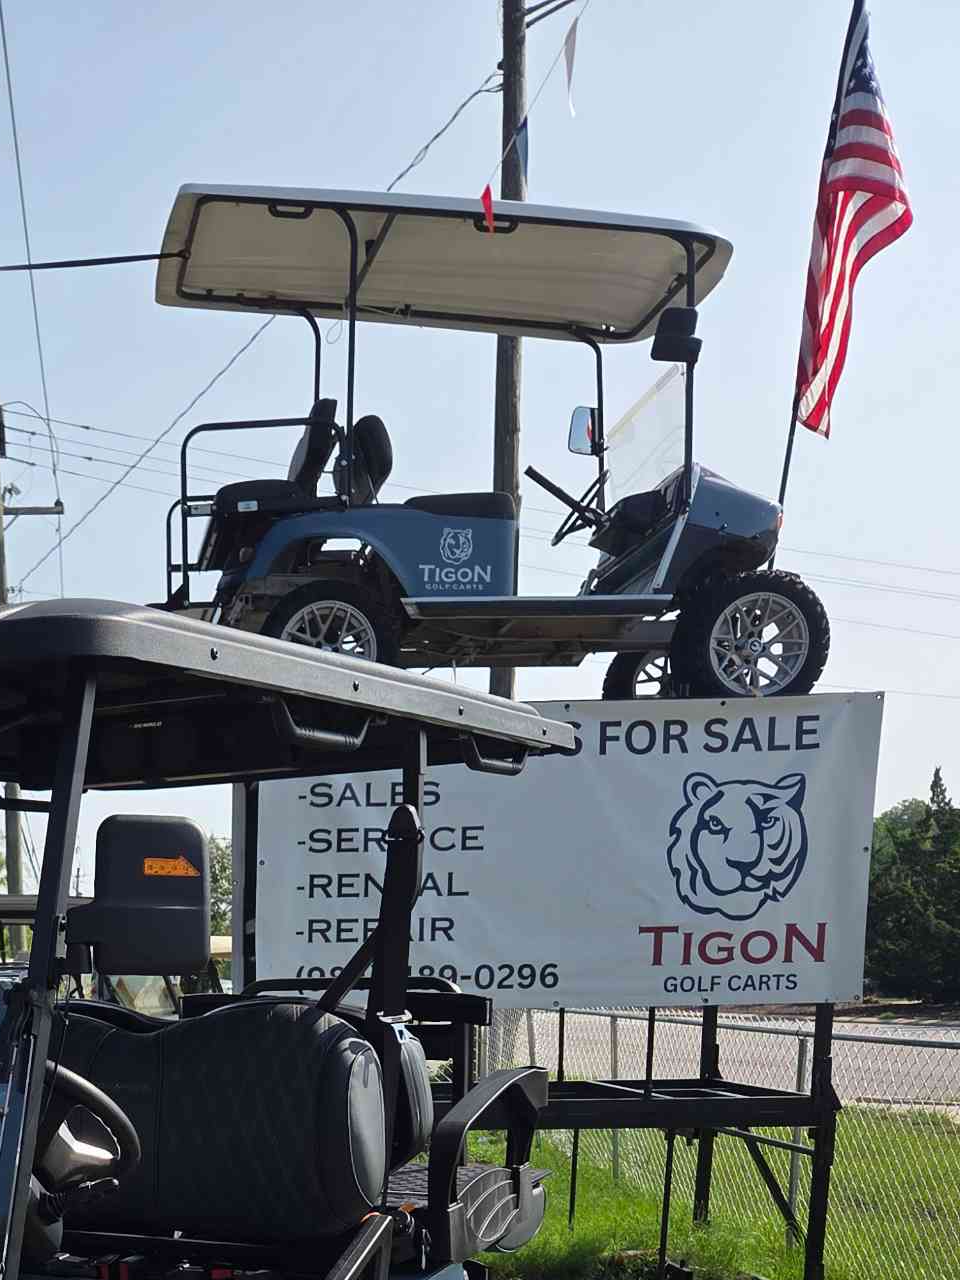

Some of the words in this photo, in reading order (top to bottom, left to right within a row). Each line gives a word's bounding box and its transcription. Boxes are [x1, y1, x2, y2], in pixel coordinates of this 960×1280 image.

[419, 564, 492, 583] TIGON
[425, 583, 450, 591] GOLF
[599, 720, 689, 755] FOR
[703, 715, 820, 753] SALE
[297, 825, 485, 854] -SERCE
[296, 871, 470, 899] -RENAL
[639, 922, 827, 966] TIGON
[663, 975, 721, 993] GOLF
[727, 973, 798, 992] CARTS
